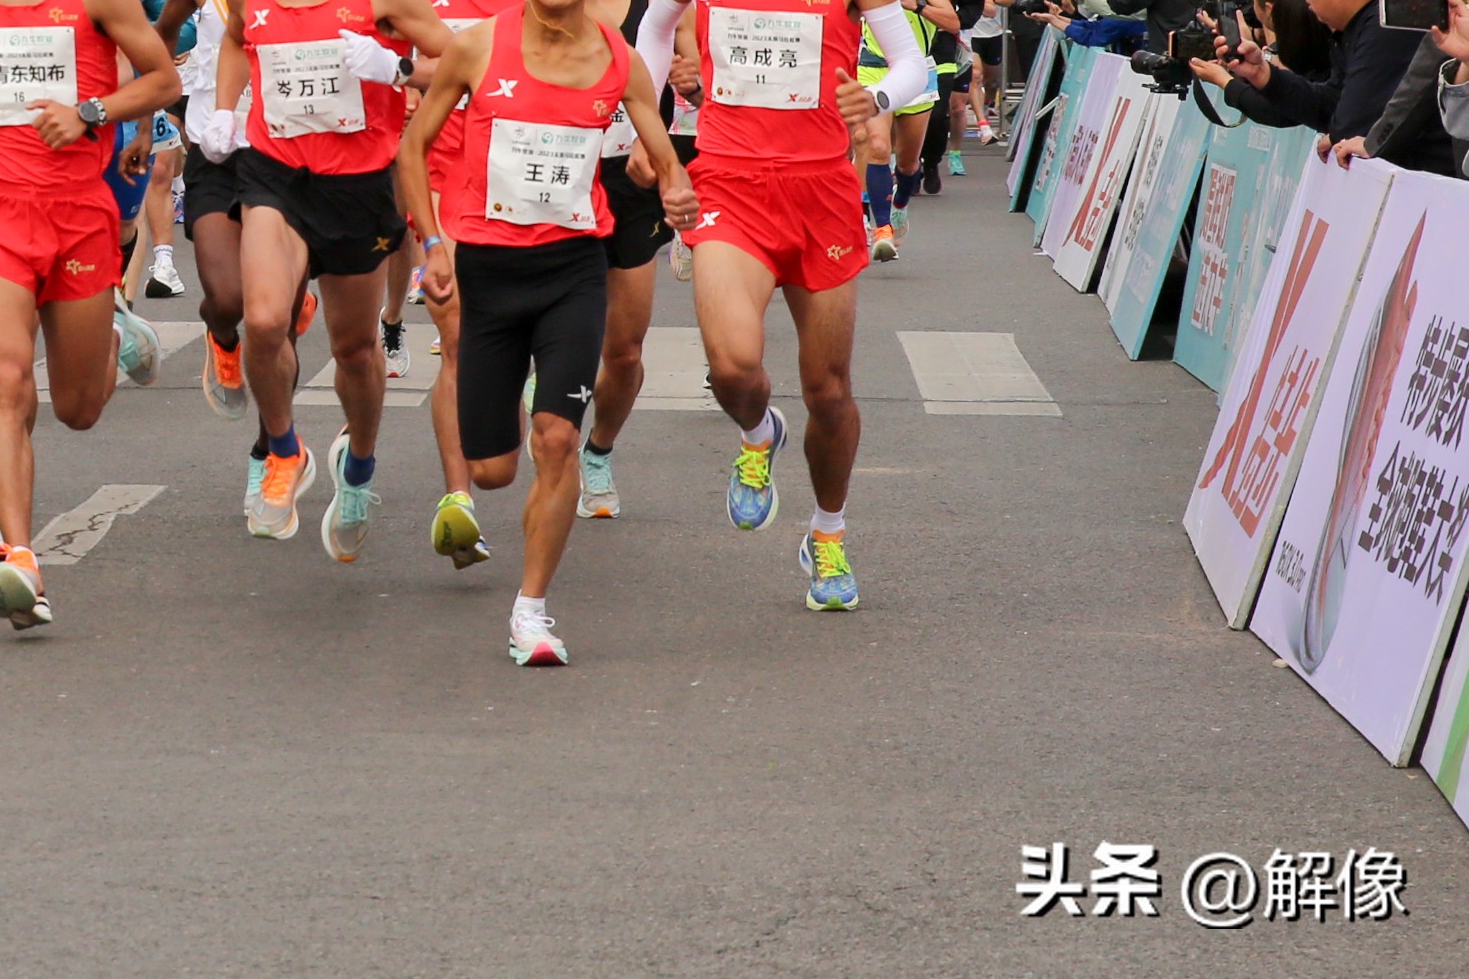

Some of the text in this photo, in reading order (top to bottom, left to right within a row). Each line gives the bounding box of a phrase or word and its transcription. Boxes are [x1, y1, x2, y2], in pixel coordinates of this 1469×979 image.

[730, 46, 797, 68] 高成亮
[756, 74, 766, 84] 11
[277, 77, 340, 98] 岑万江
[14, 92, 25, 102] 16
[303, 104, 314, 115] 13
[524, 163, 570, 185] 王涛
[539, 192, 551, 203] 12
